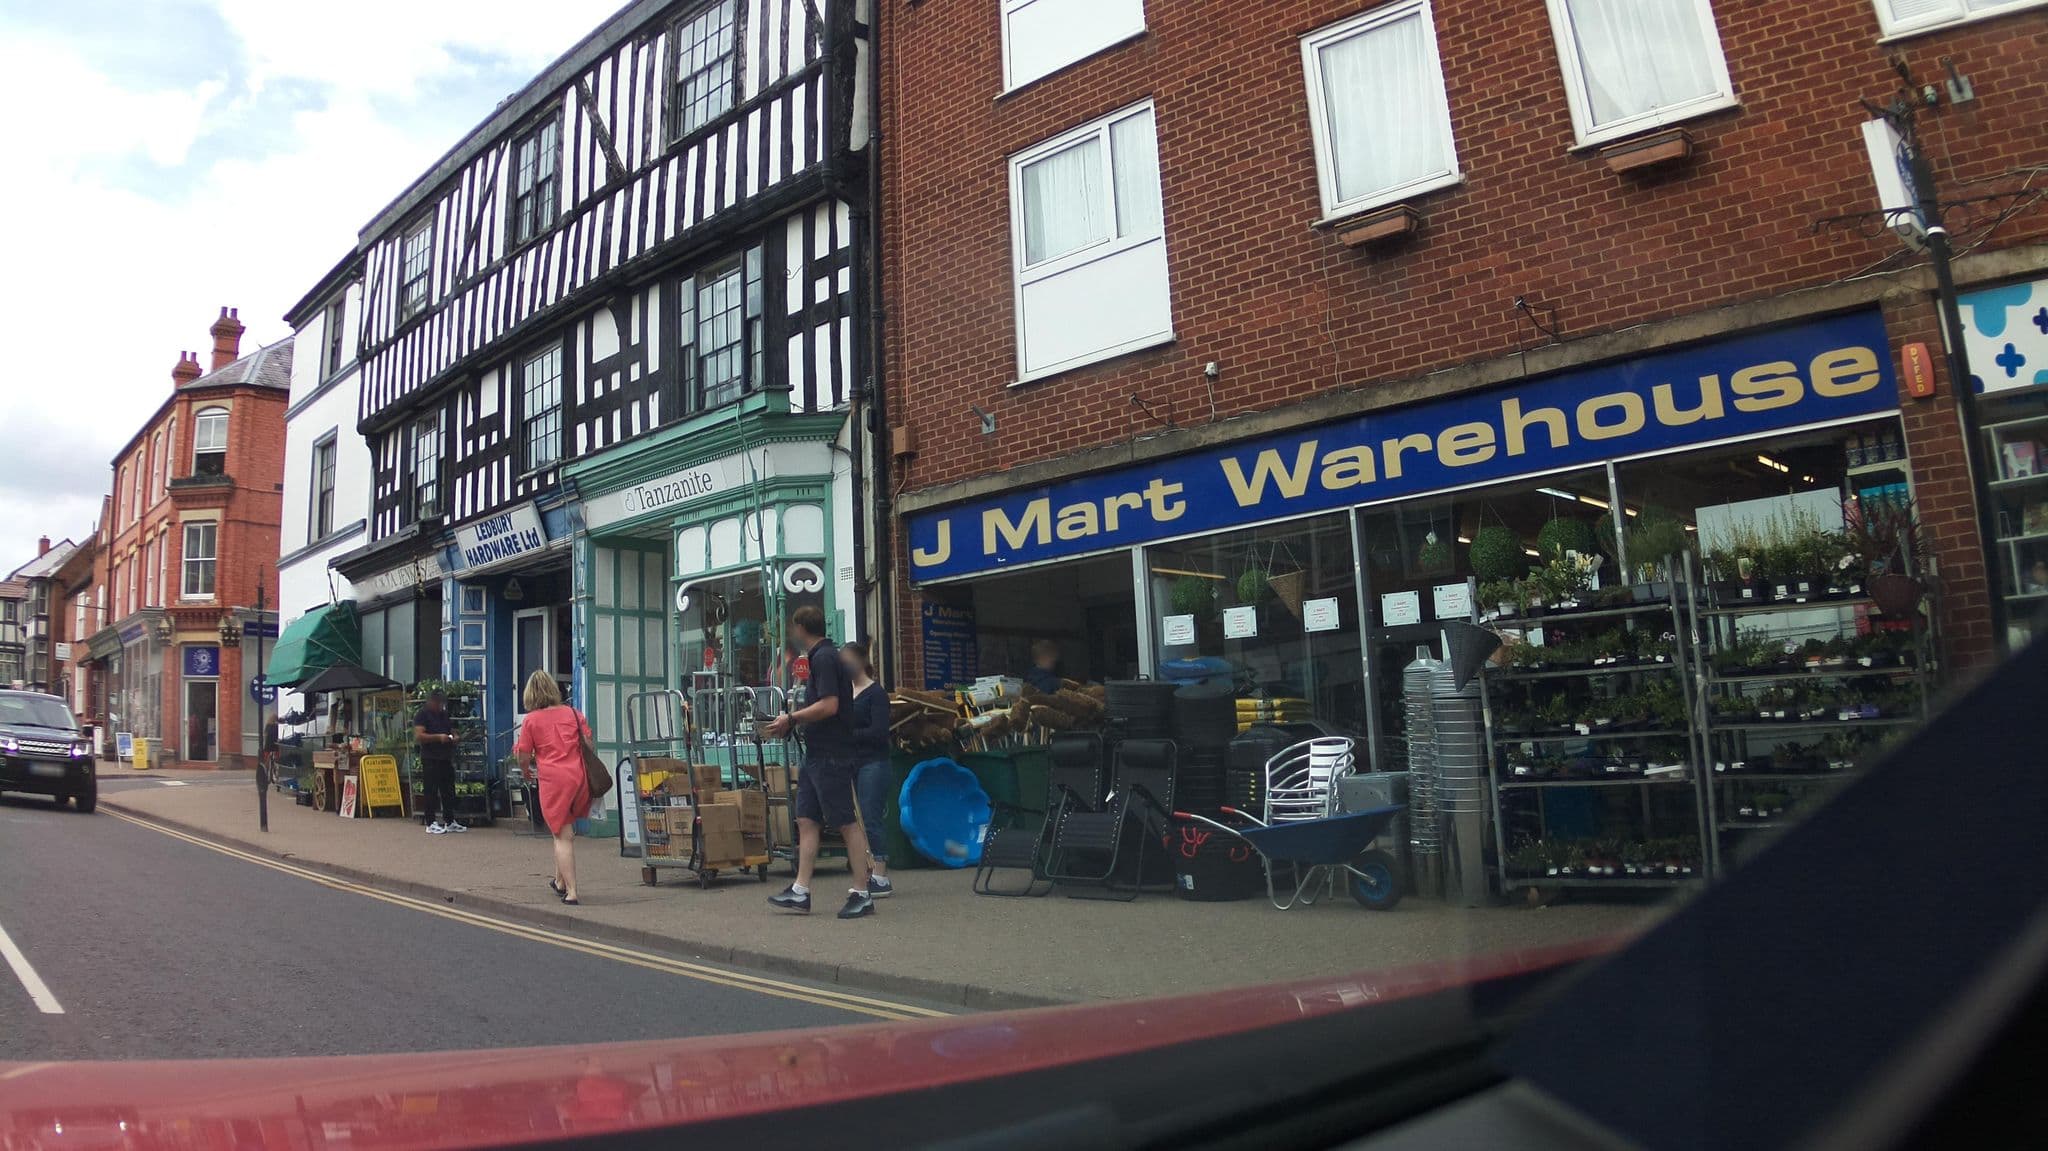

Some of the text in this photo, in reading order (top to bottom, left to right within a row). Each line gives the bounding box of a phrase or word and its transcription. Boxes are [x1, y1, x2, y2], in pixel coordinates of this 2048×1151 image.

[1910, 346, 1925, 393] DYFED
[912, 346, 1880, 567] J Mart Warehouse
[635, 469, 714, 511] Tanzanite
[474, 511, 513, 542] LEDBURY
[464, 534, 521, 569] HARDWARE
[523, 527, 541, 549] Ltd
